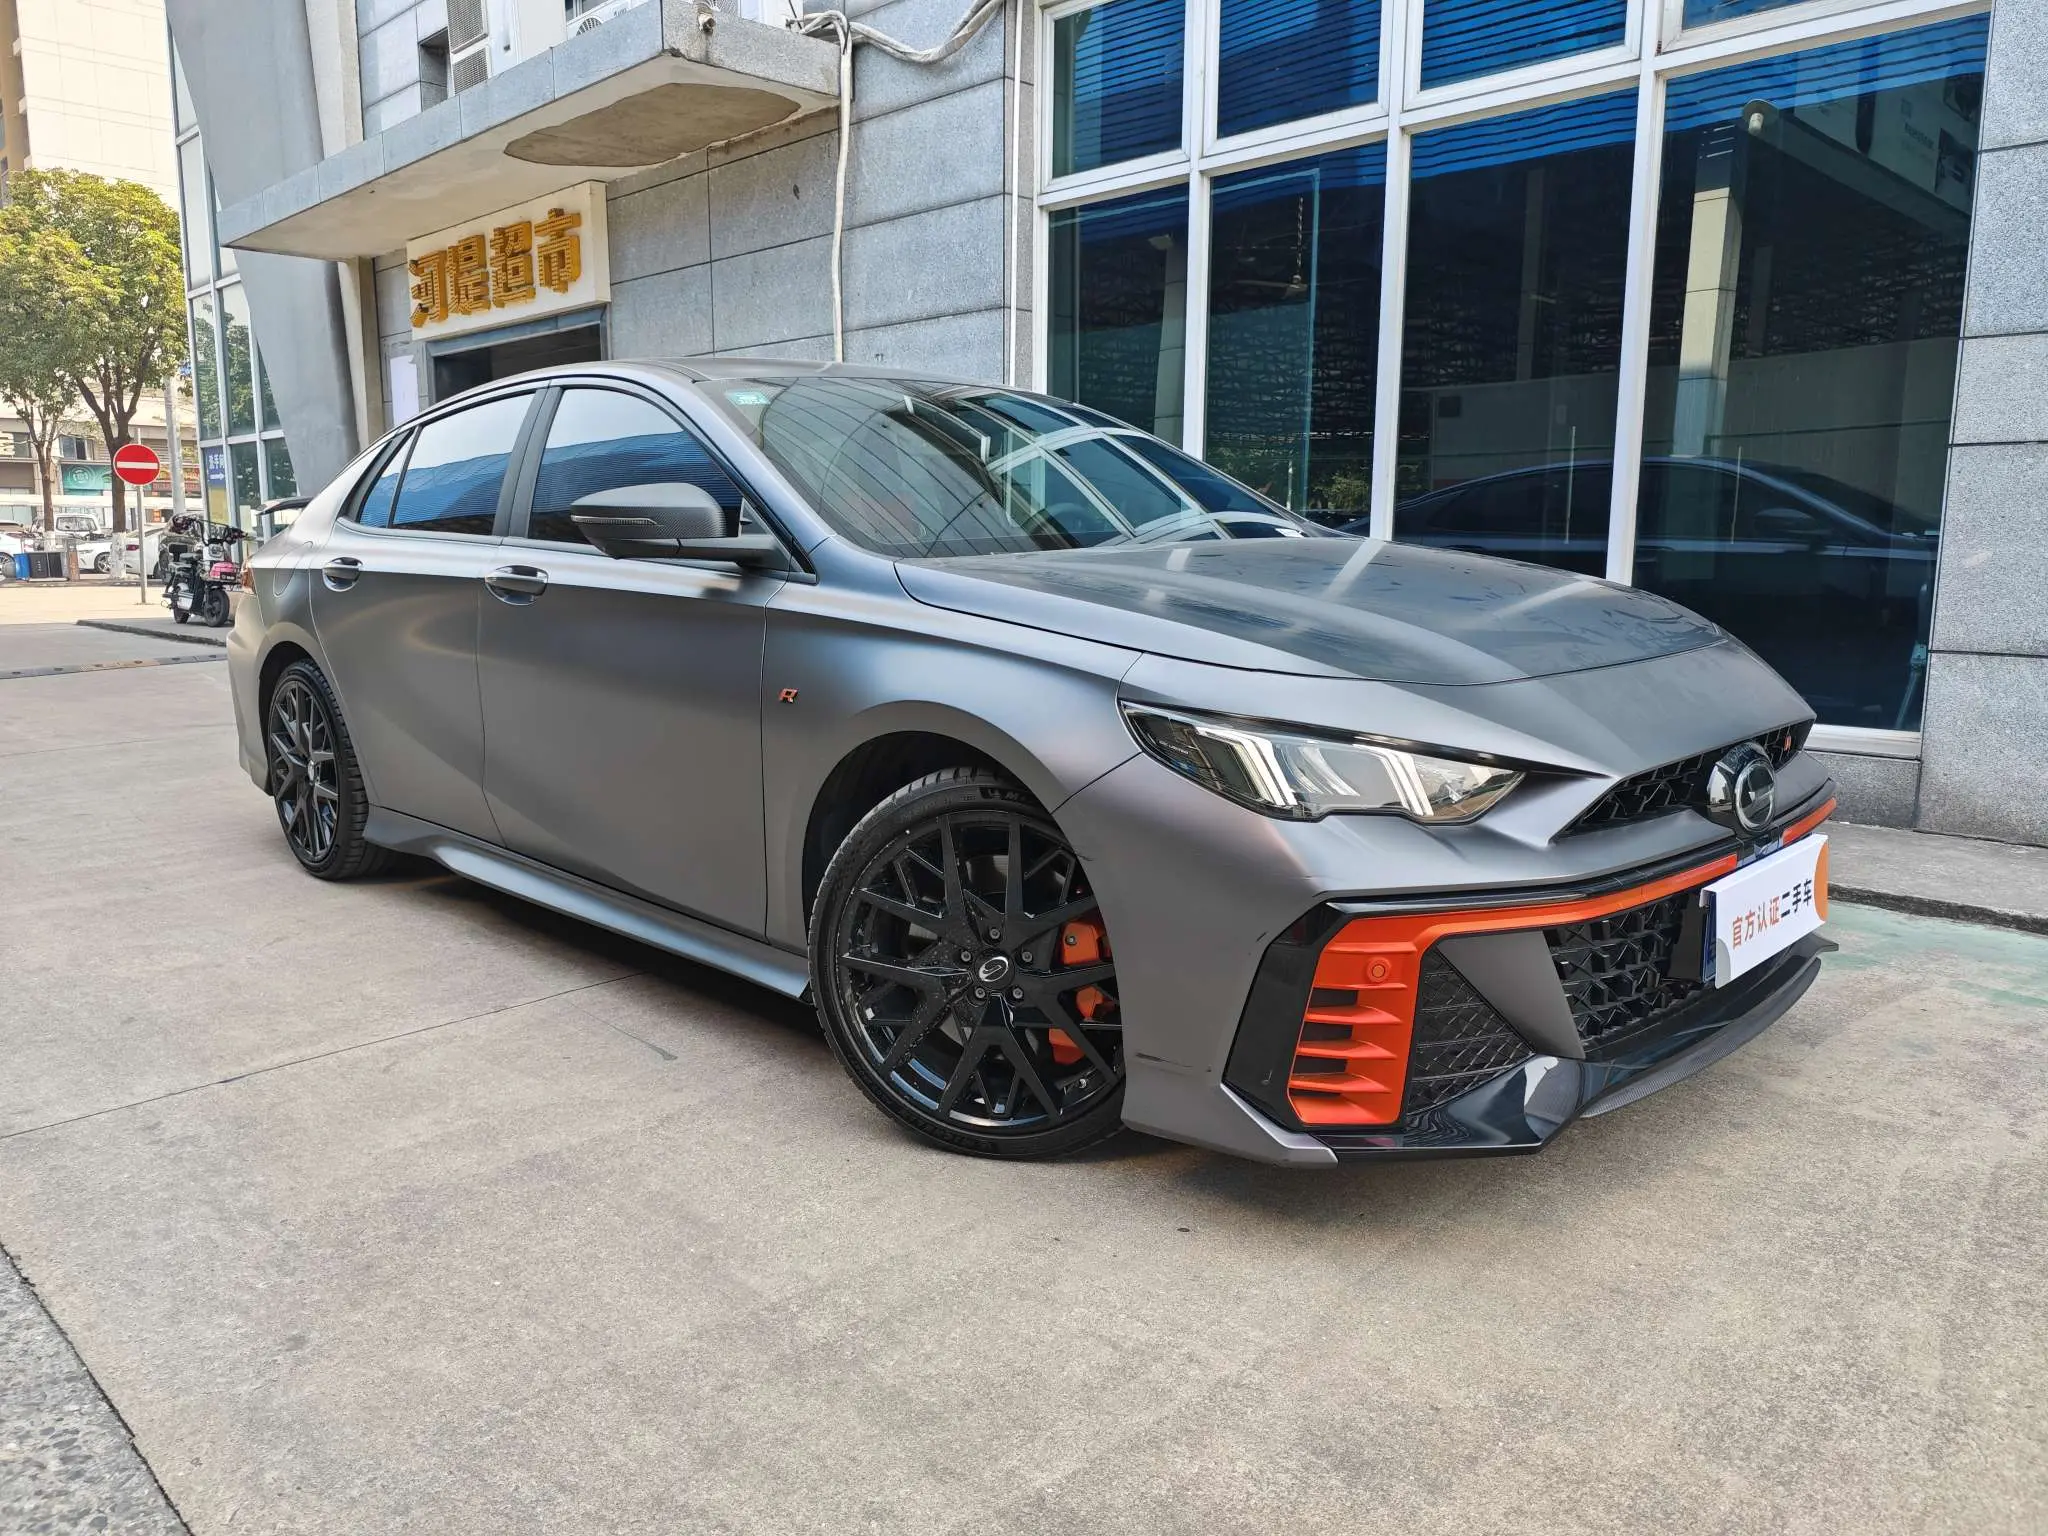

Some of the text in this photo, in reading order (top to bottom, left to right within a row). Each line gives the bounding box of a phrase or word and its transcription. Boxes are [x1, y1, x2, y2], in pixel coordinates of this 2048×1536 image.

[1732, 879, 1812, 950] 官方认证二手车
